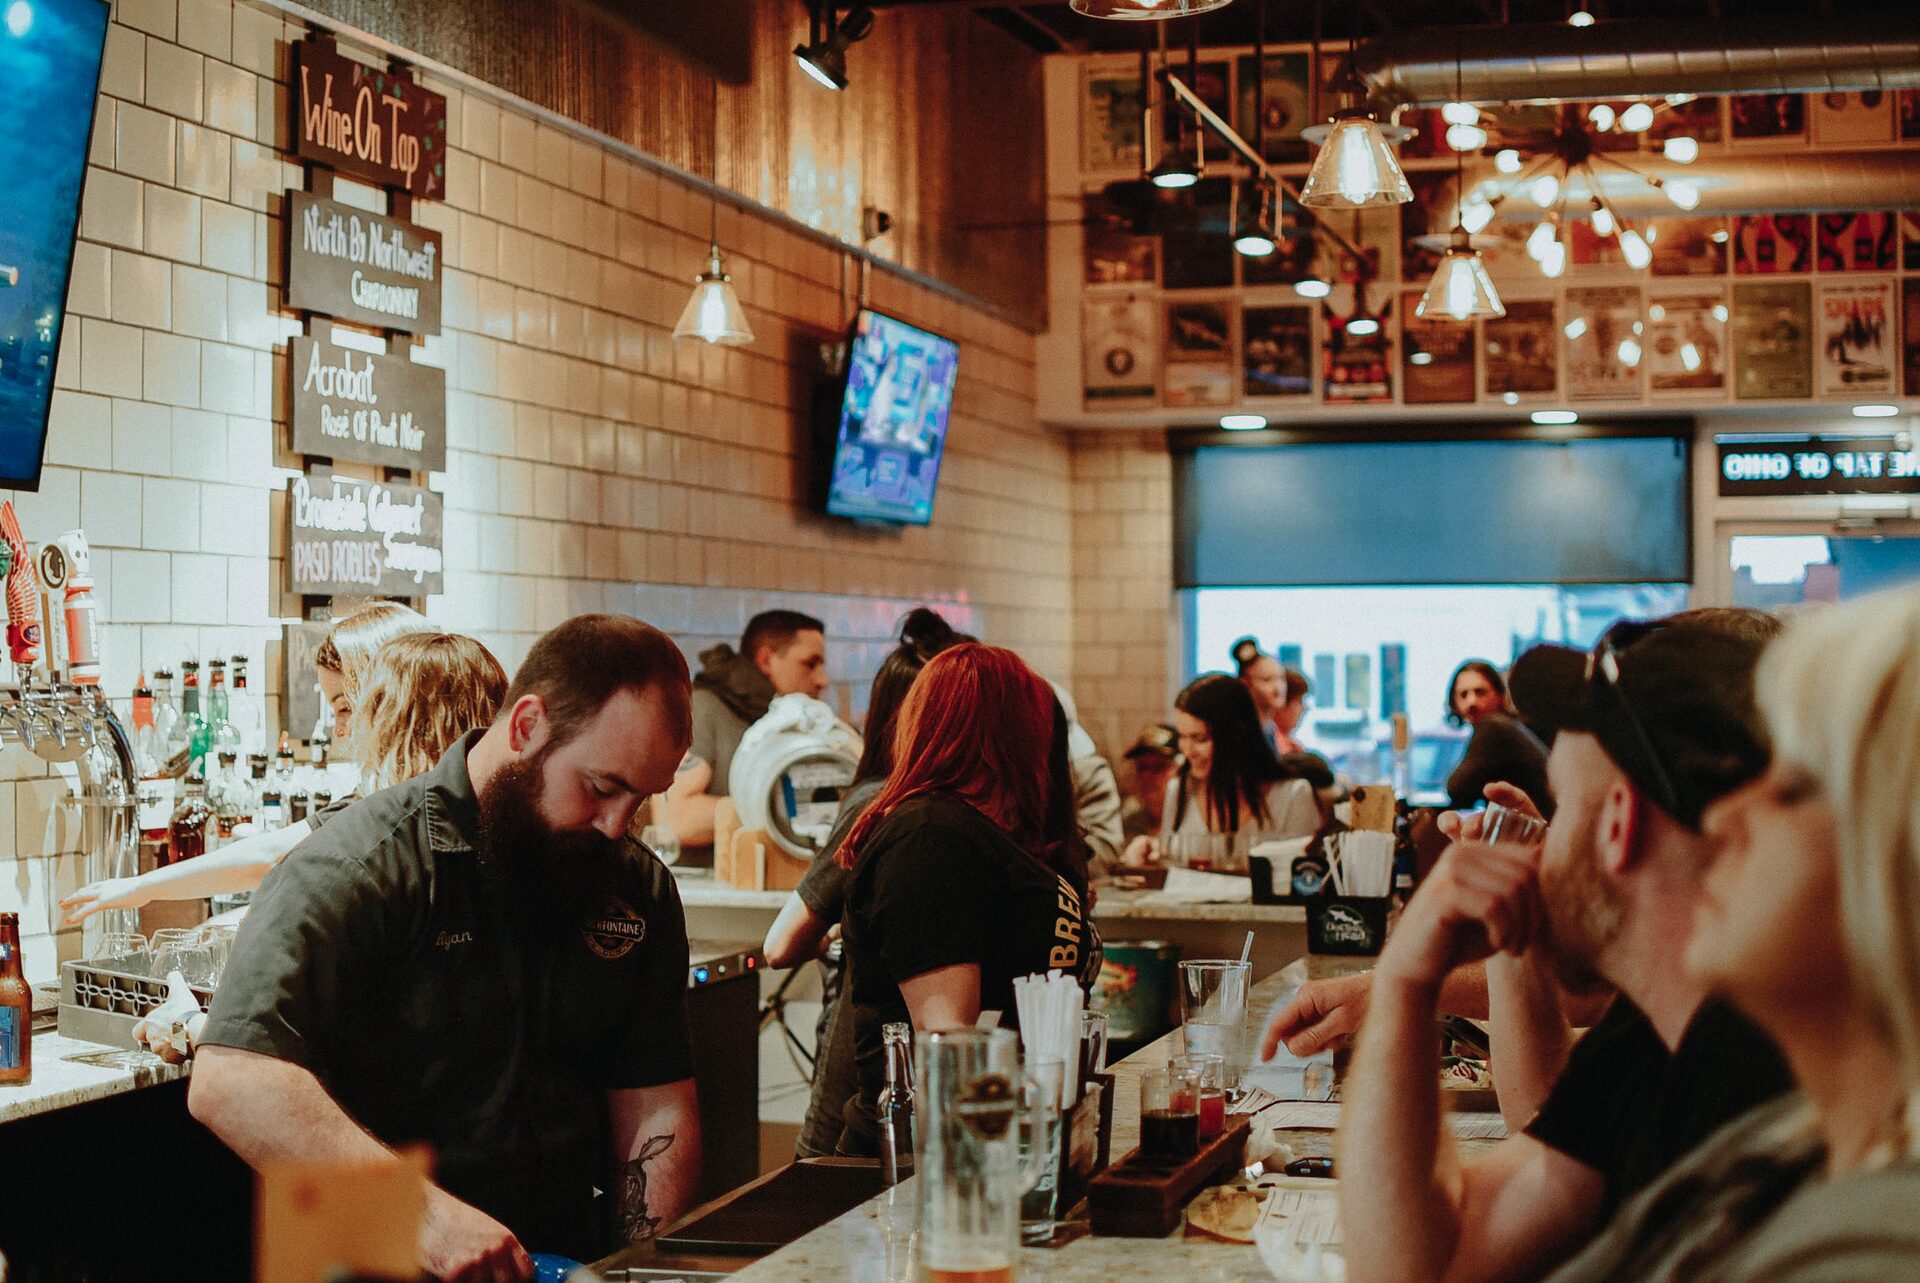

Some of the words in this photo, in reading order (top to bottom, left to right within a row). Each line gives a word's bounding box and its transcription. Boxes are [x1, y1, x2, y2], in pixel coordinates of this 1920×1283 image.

[301, 65, 353, 155] Wine
[355, 85, 382, 165] On
[382, 94, 420, 189] Tap
[303, 203, 347, 258] North
[368, 222, 436, 281] Northwest
[303, 341, 377, 404] Acrobat
[295, 541, 330, 583] PASO
[332, 540, 381, 586] ROBLES
[435, 929, 473, 950] Ryan
[1049, 874, 1081, 967] BREW
